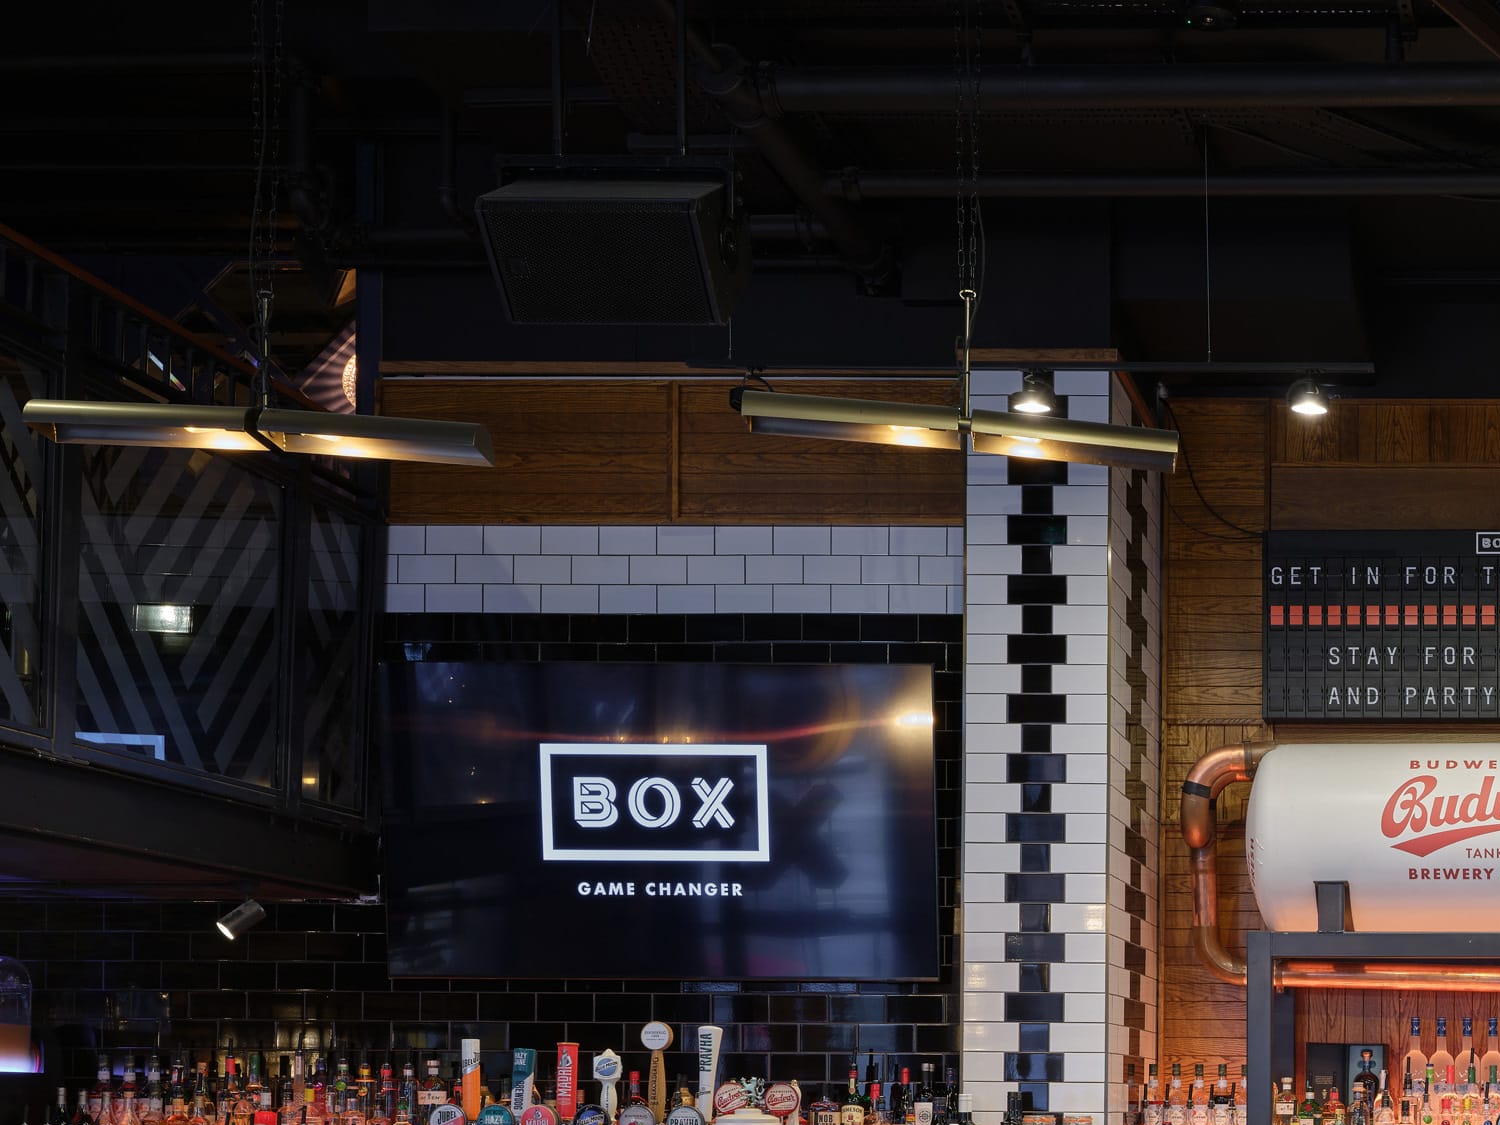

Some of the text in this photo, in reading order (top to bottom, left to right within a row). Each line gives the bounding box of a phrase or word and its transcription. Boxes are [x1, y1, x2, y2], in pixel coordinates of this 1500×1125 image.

[1271, 567, 1321, 585] GET
[1351, 567, 1380, 585] IN
[1405, 567, 1456, 585] FOR
[1329, 647, 1398, 666] STAY
[1425, 647, 1475, 665] FOR
[1329, 687, 1380, 705] AND
[1405, 687, 1494, 705] PARTY
[573, 776, 735, 829] BOX
[1408, 868, 1493, 880] BREWERY
[578, 882, 743, 896] GAME CHANGER
[700, 1033, 712, 1072] PRAVHA
[437, 1110, 457, 1125] JUBEL
[485, 1115, 504, 1125] HAZY
